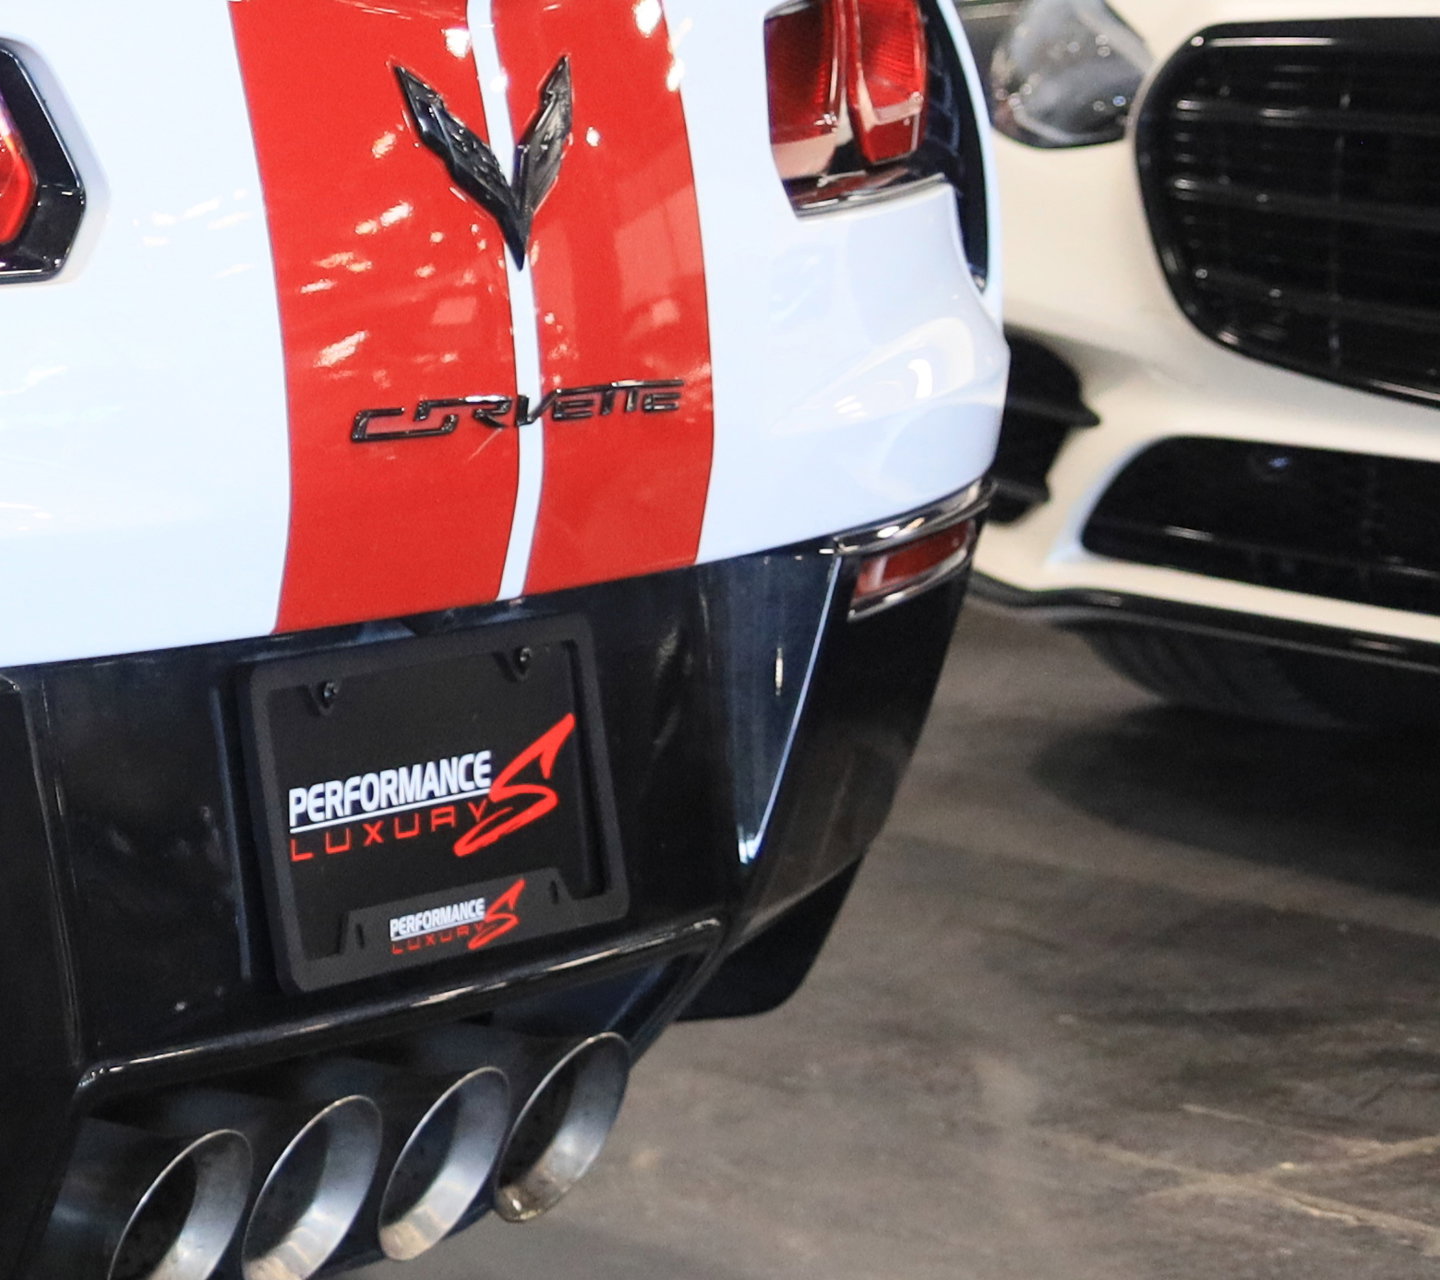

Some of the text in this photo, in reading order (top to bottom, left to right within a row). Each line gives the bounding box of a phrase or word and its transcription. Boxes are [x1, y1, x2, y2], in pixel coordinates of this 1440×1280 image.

[350, 378, 685, 444] CORVETTE
[288, 749, 493, 827] PERFORMANCE
[290, 798, 489, 862] LUXURY
[389, 897, 486, 940] PERFORMANCE
[391, 922, 486, 955] LUXURY
